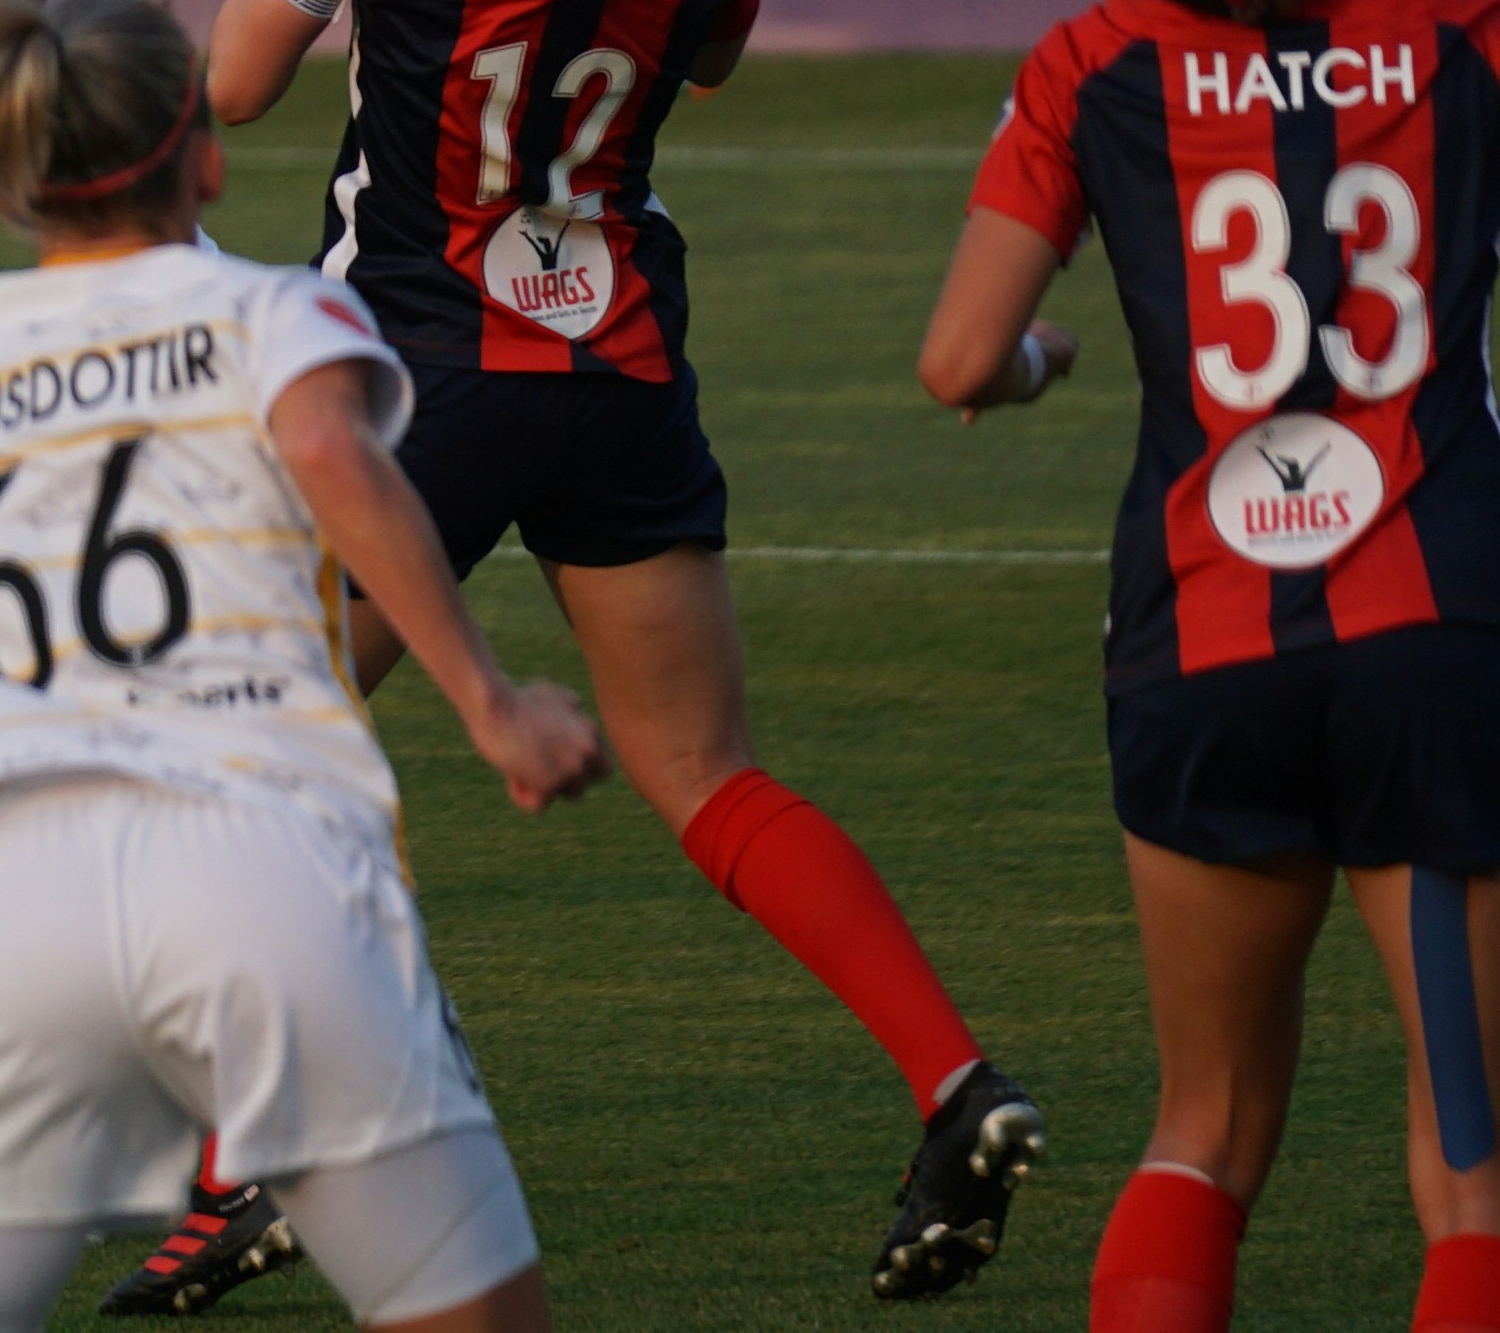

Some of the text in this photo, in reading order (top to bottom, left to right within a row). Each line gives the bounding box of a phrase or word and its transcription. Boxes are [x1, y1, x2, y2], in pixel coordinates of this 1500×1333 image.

[1183, 43, 1417, 116] HATCH
[469, 40, 637, 221] 12
[510, 265, 596, 313] WAGS
[1190, 161, 1431, 411] 33
[1243, 489, 1352, 537] WAGS
